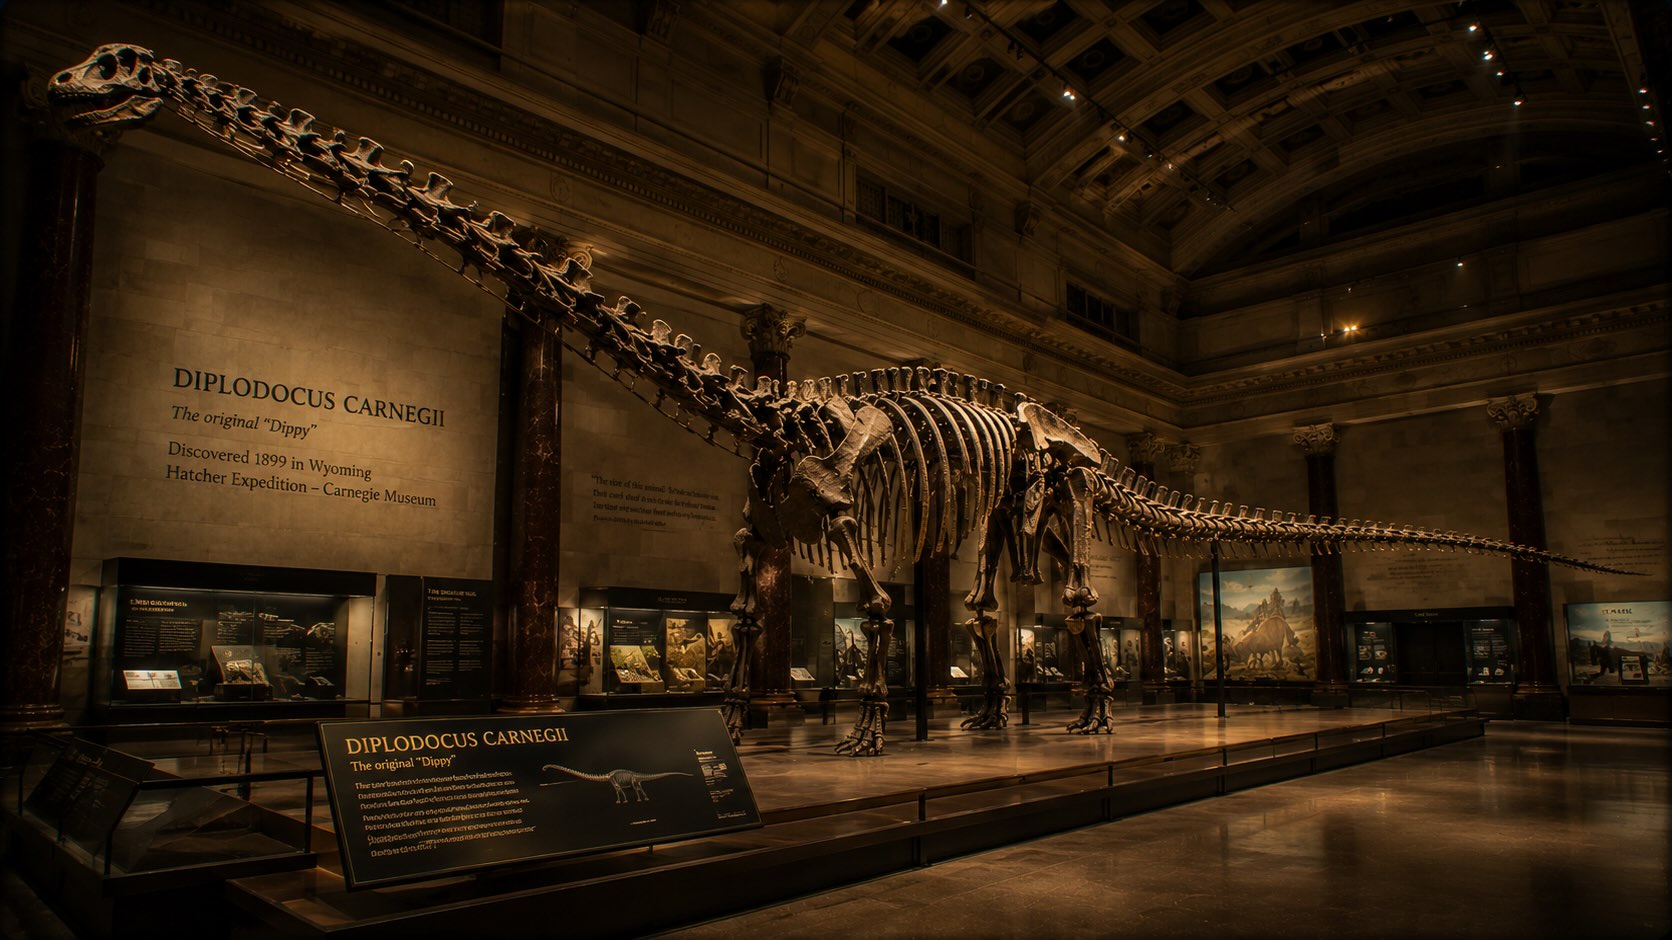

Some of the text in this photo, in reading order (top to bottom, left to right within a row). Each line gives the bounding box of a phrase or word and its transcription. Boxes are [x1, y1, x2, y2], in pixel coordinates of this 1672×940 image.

[173, 367, 445, 427] DIPLODOCUS CARNEGII
[172, 405, 317, 440] The original “Dippy”
[168, 441, 372, 482] Discovered 1899 in Wyoming
[165, 464, 227, 485] Hatcher
[231, 472, 307, 493] Expedition
[323, 482, 380, 503] Carnegie
[384, 489, 436, 507] Museum
[345, 727, 569, 755] DIPLODOCUS CARNEGII
[350, 754, 456, 772] The original “Dippy”
